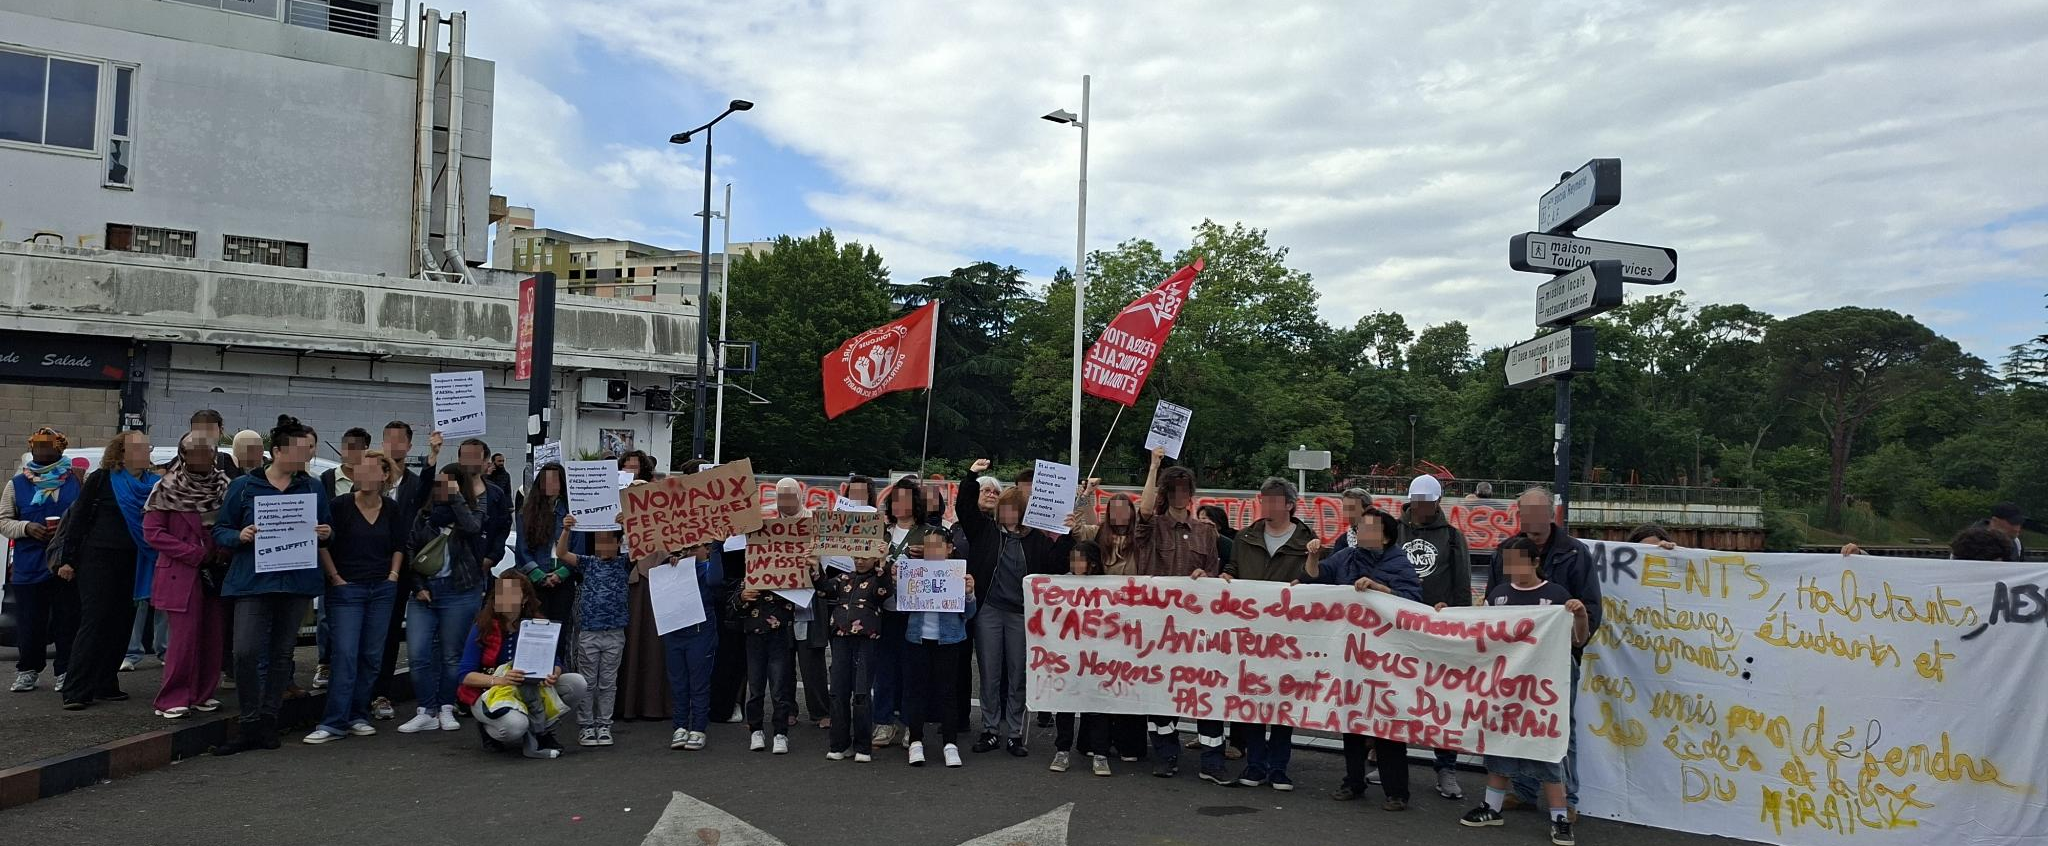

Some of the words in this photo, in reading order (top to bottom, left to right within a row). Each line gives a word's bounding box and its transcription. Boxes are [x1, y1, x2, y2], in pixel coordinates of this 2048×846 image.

[1550, 241, 1592, 256] maison
[1620, 262, 1653, 276] vices
[1545, 282, 1565, 301] mission
[1567, 274, 1586, 292] locale
[1544, 299, 1569, 318] restaurant
[1528, 344, 1548, 359] nautique
[1548, 340, 1554, 352] et
[1554, 335, 1570, 350] loisirs
[40, 354, 92, 367] Salade
[1548, 354, 1570, 370] chteau
[450, 412, 480, 423] SUFFIT
[628, 489, 686, 514] NON
[688, 476, 747, 508] AUX
[584, 504, 612, 514] SUFFIT
[626, 497, 752, 533] FERMETURES
[839, 513, 880, 526] VOULONS
[628, 528, 656, 550] DE
[662, 516, 731, 537] CLASSES
[748, 518, 810, 538] ROLÉ
[812, 524, 832, 534] DES
[832, 524, 878, 536] MOYENS
[274, 540, 308, 552] SUFFIT
[632, 544, 656, 560] AU
[662, 524, 738, 553] MIRA
[1596, 542, 1787, 612] ARENTS,
[1989, 582, 2048, 624] AES
[1030, 576, 1204, 614] Fermeture
[1210, 588, 1260, 620] des
[1396, 608, 1538, 653] manque
[1602, 589, 1735, 642] nimateurs
[1913, 640, 1956, 682] et
[1168, 665, 1230, 694] pour
[1238, 659, 1275, 696] les
[1344, 632, 1420, 680] Nous
[1424, 655, 1560, 706] voulons
[1582, 653, 1636, 702] Tous
[1650, 690, 1717, 726] unis
[1172, 687, 1214, 718] PAS
[1224, 694, 1296, 729] POUR
[1302, 706, 1340, 732] LA
